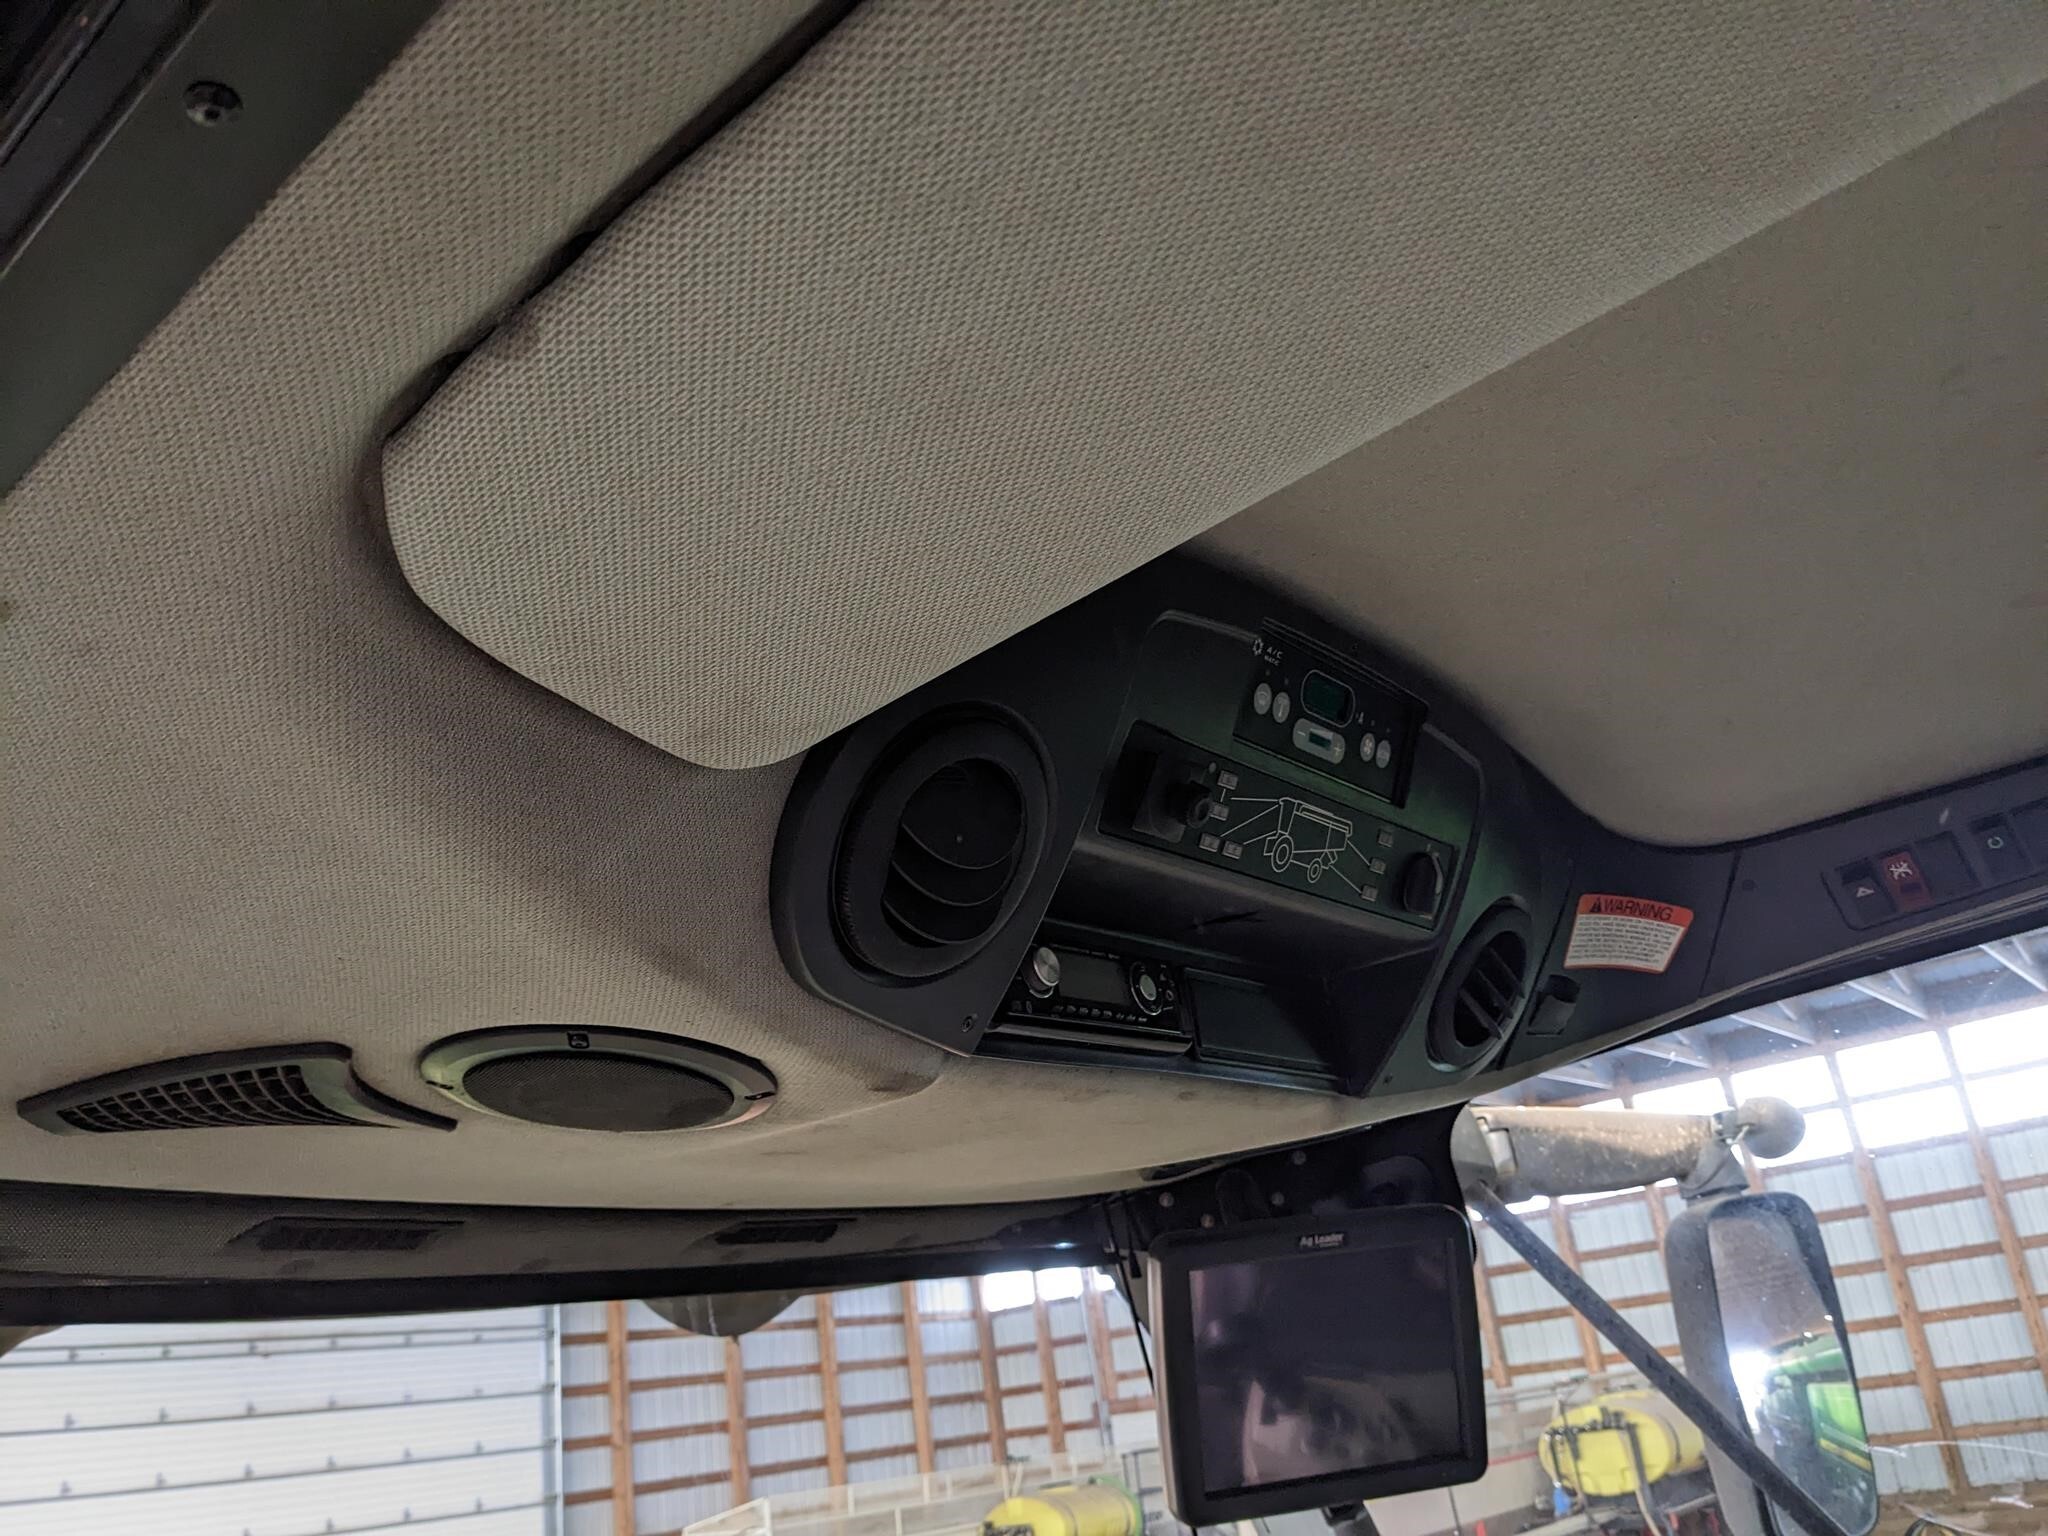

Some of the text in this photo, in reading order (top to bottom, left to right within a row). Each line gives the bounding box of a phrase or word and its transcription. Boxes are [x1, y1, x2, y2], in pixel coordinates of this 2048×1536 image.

[1266, 646, 1284, 660] A/C
[1604, 898, 1673, 922] WARNING
[1314, 1233, 1345, 1244] Leader
